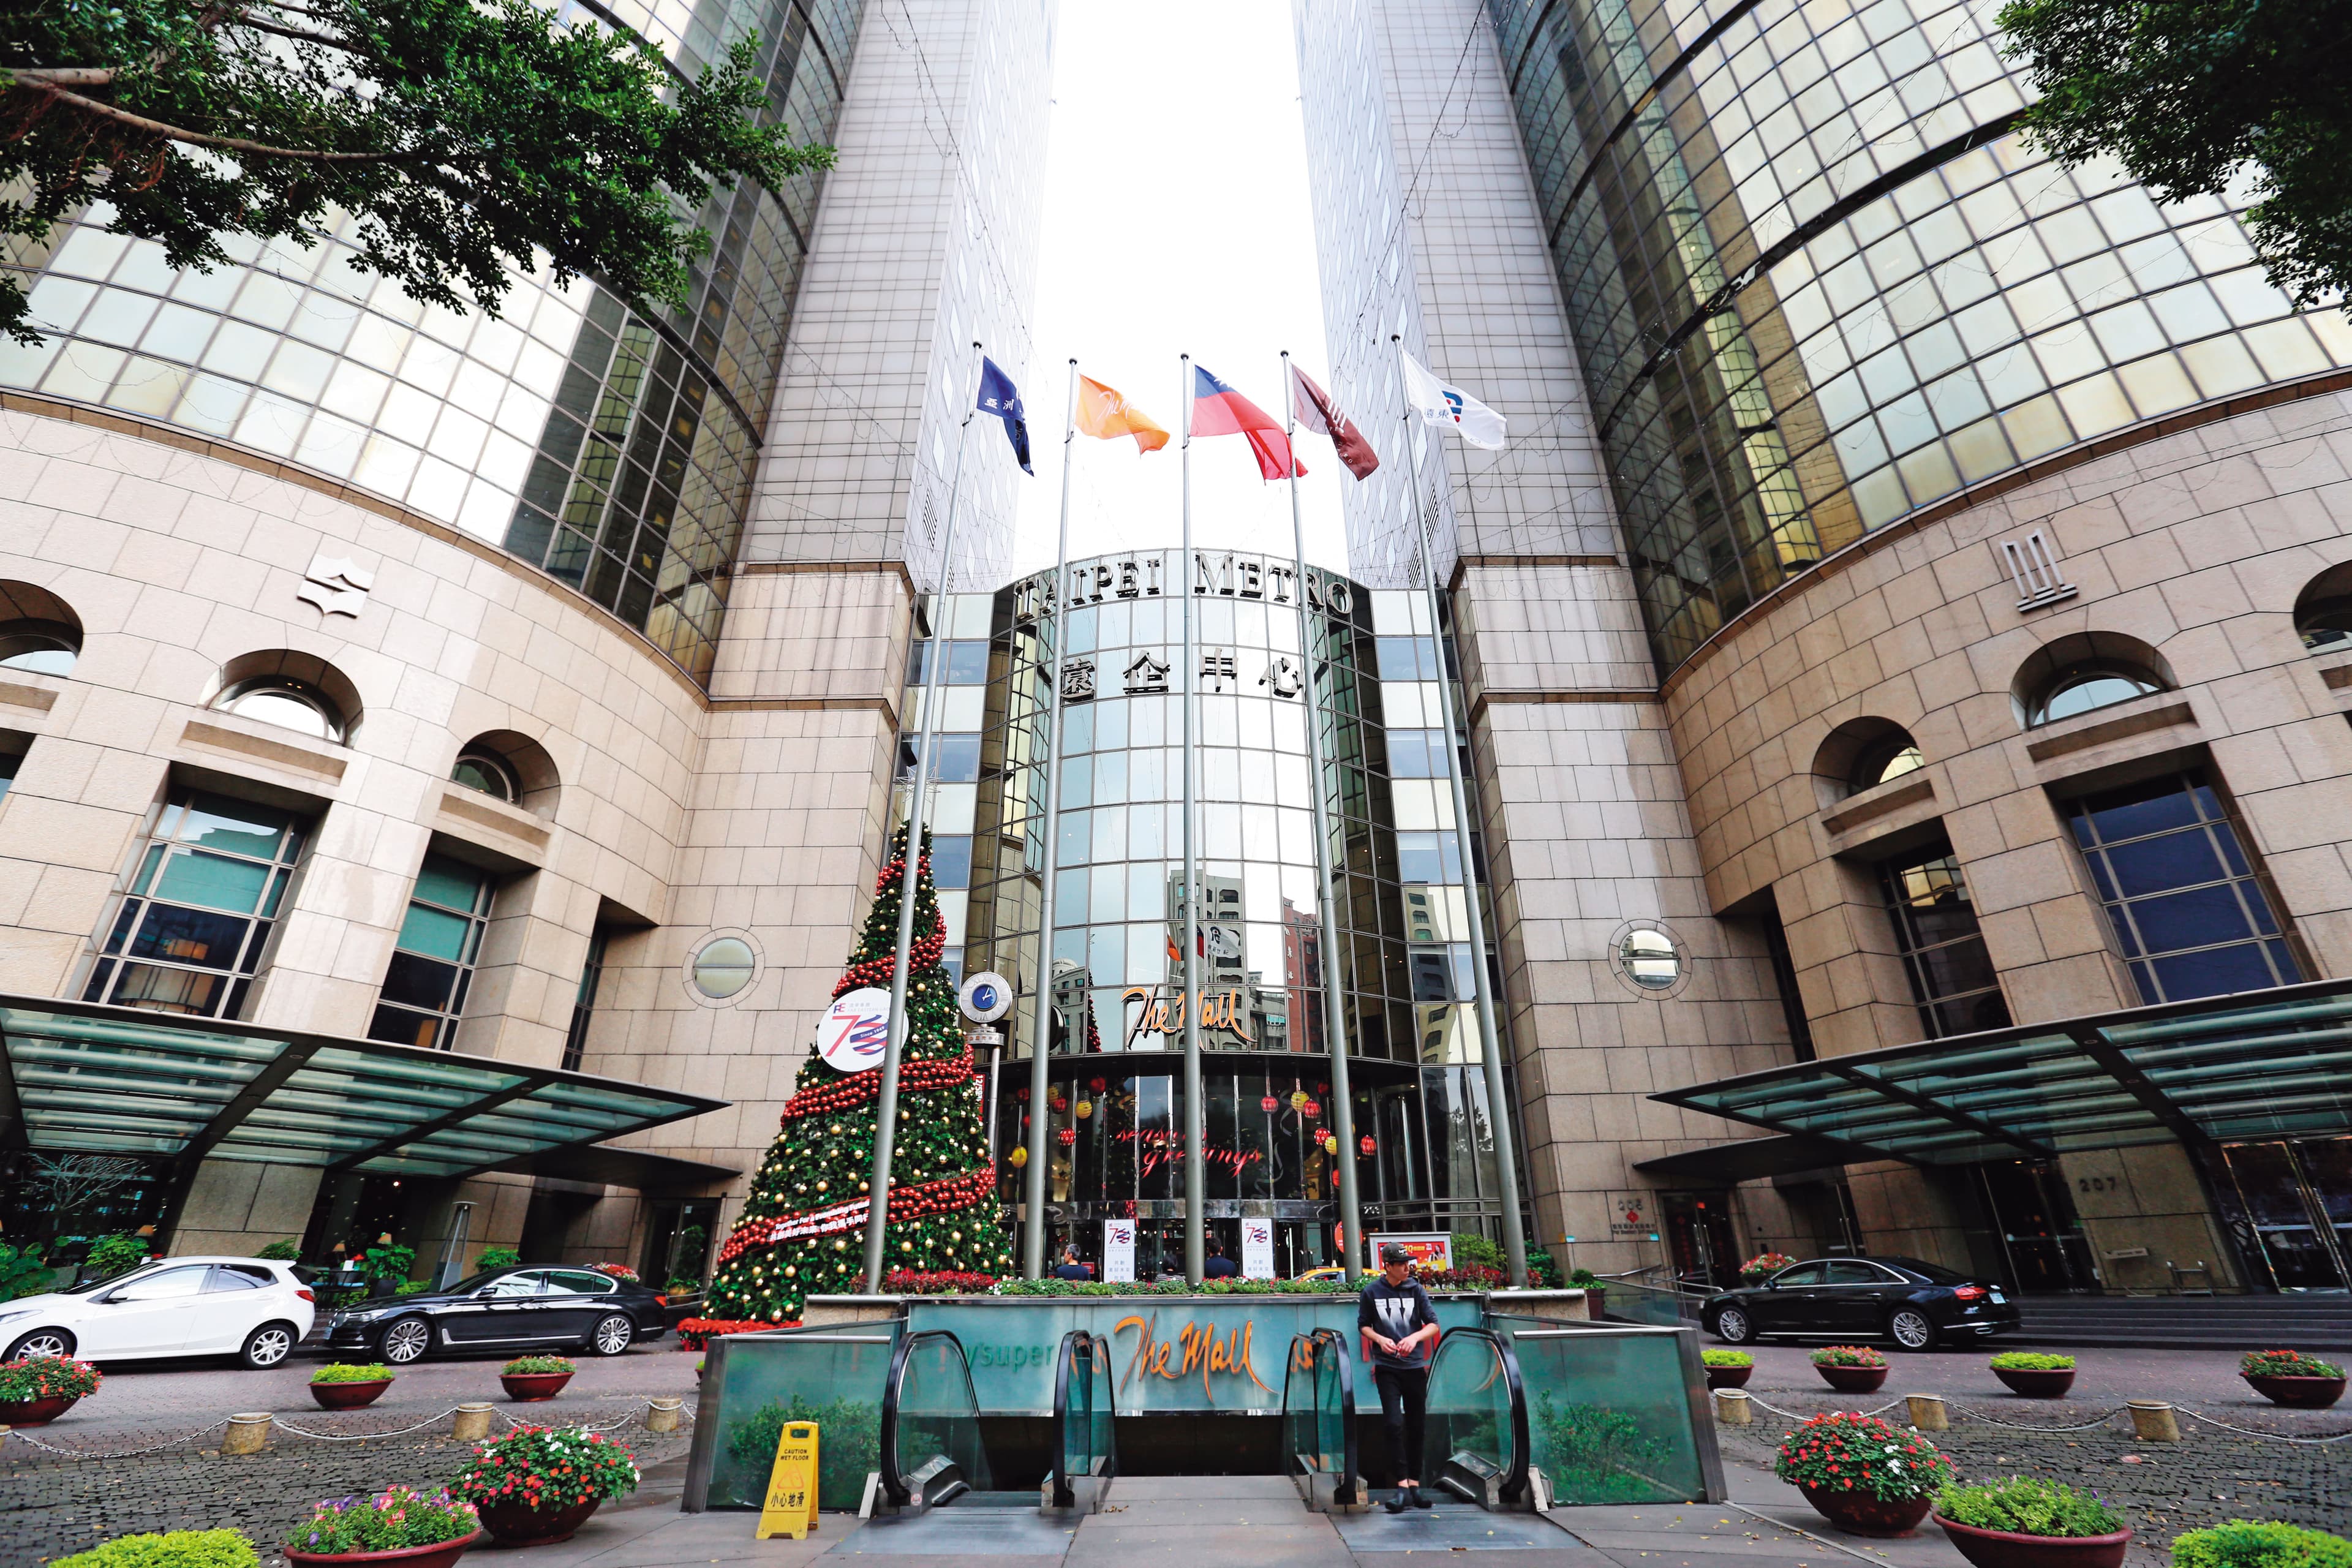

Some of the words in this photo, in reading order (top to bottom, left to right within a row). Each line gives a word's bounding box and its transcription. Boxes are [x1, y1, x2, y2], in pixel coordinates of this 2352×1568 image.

[1014, 559, 1160, 622] TAIPEI
[1195, 553, 1353, 614] METRO
[1121, 984, 1177, 1050] The
[2079, 1176, 2118, 1193] 207
[1374, 1298, 1415, 1335] W
[1114, 1309, 1182, 1396] The
[1180, 1320, 1279, 1404] Mall
[771, 1491, 804, 1507] 小心地滑
